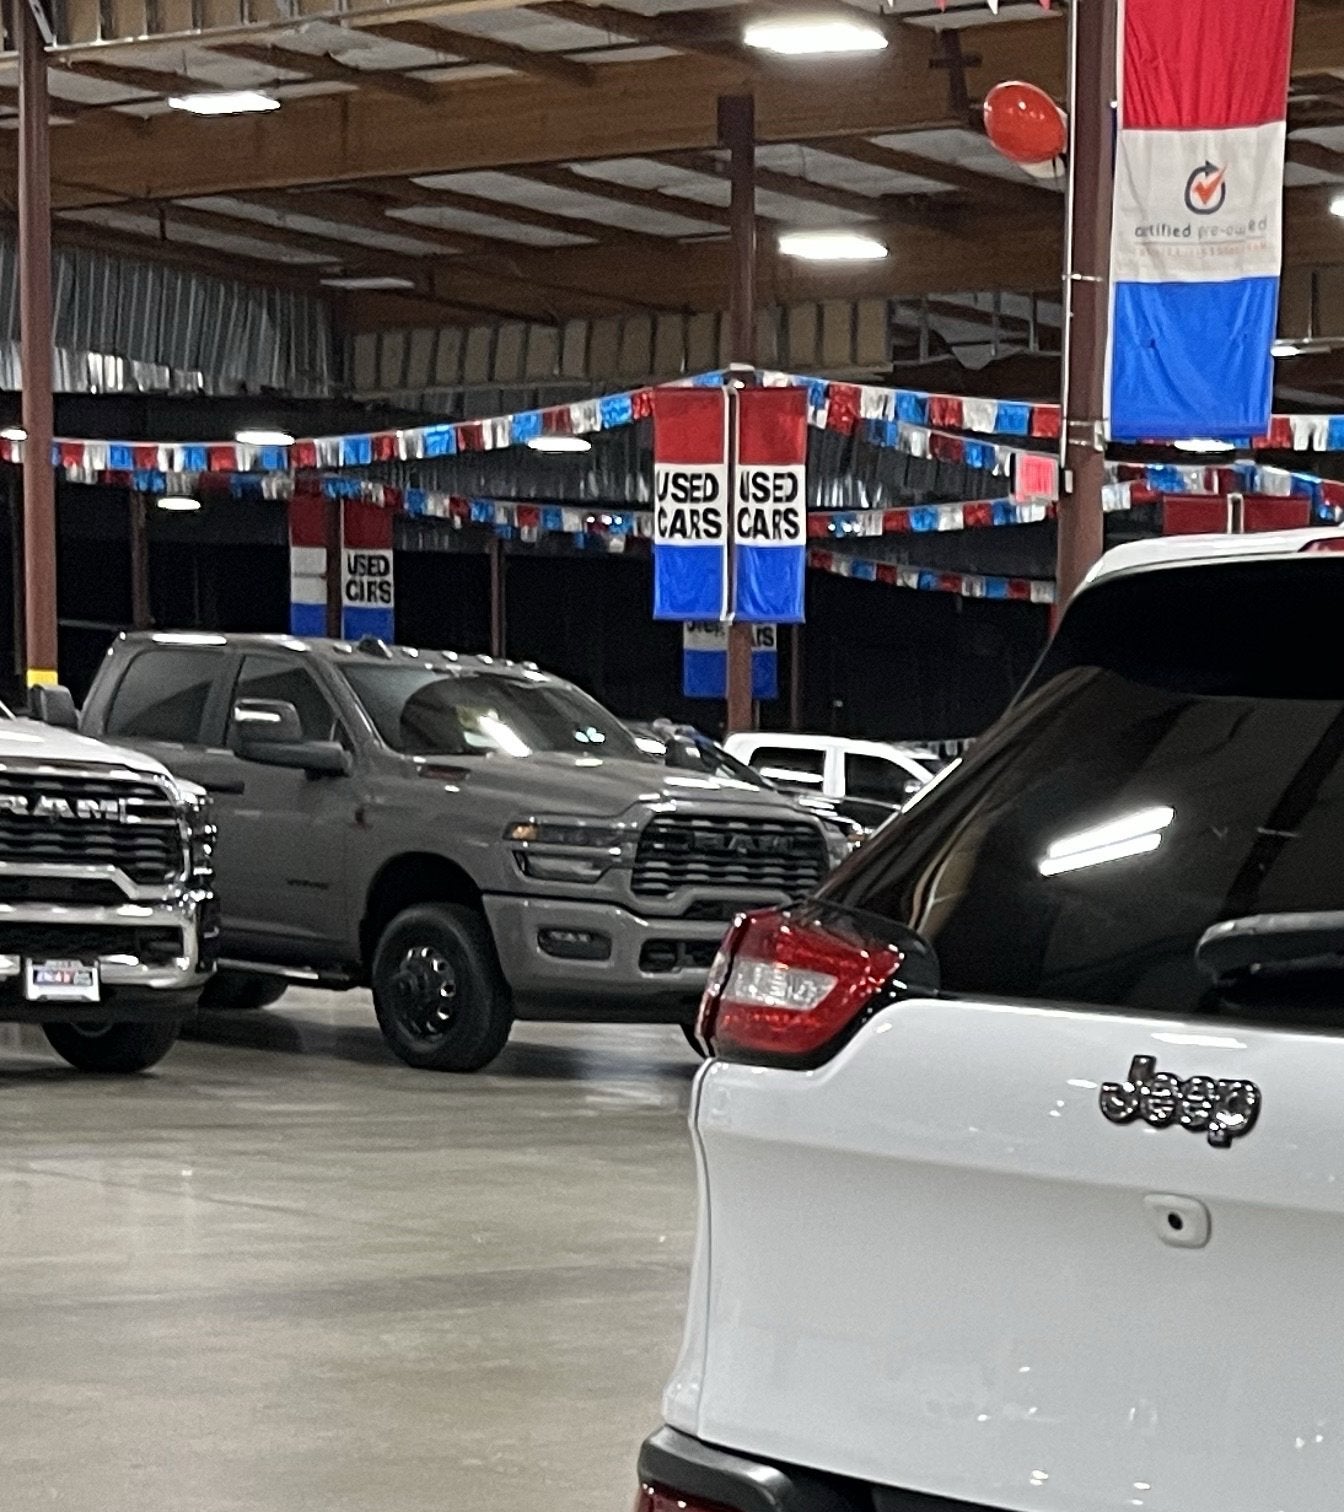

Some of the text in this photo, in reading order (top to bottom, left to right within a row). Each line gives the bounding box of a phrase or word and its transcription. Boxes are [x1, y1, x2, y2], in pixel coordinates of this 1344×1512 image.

[656, 471, 719, 503] USED
[740, 471, 798, 503] USED
[658, 506, 722, 539] CARS
[737, 506, 800, 539] CARS
[347, 553, 390, 577] USED
[1099, 1054, 1262, 1149] Jeep
